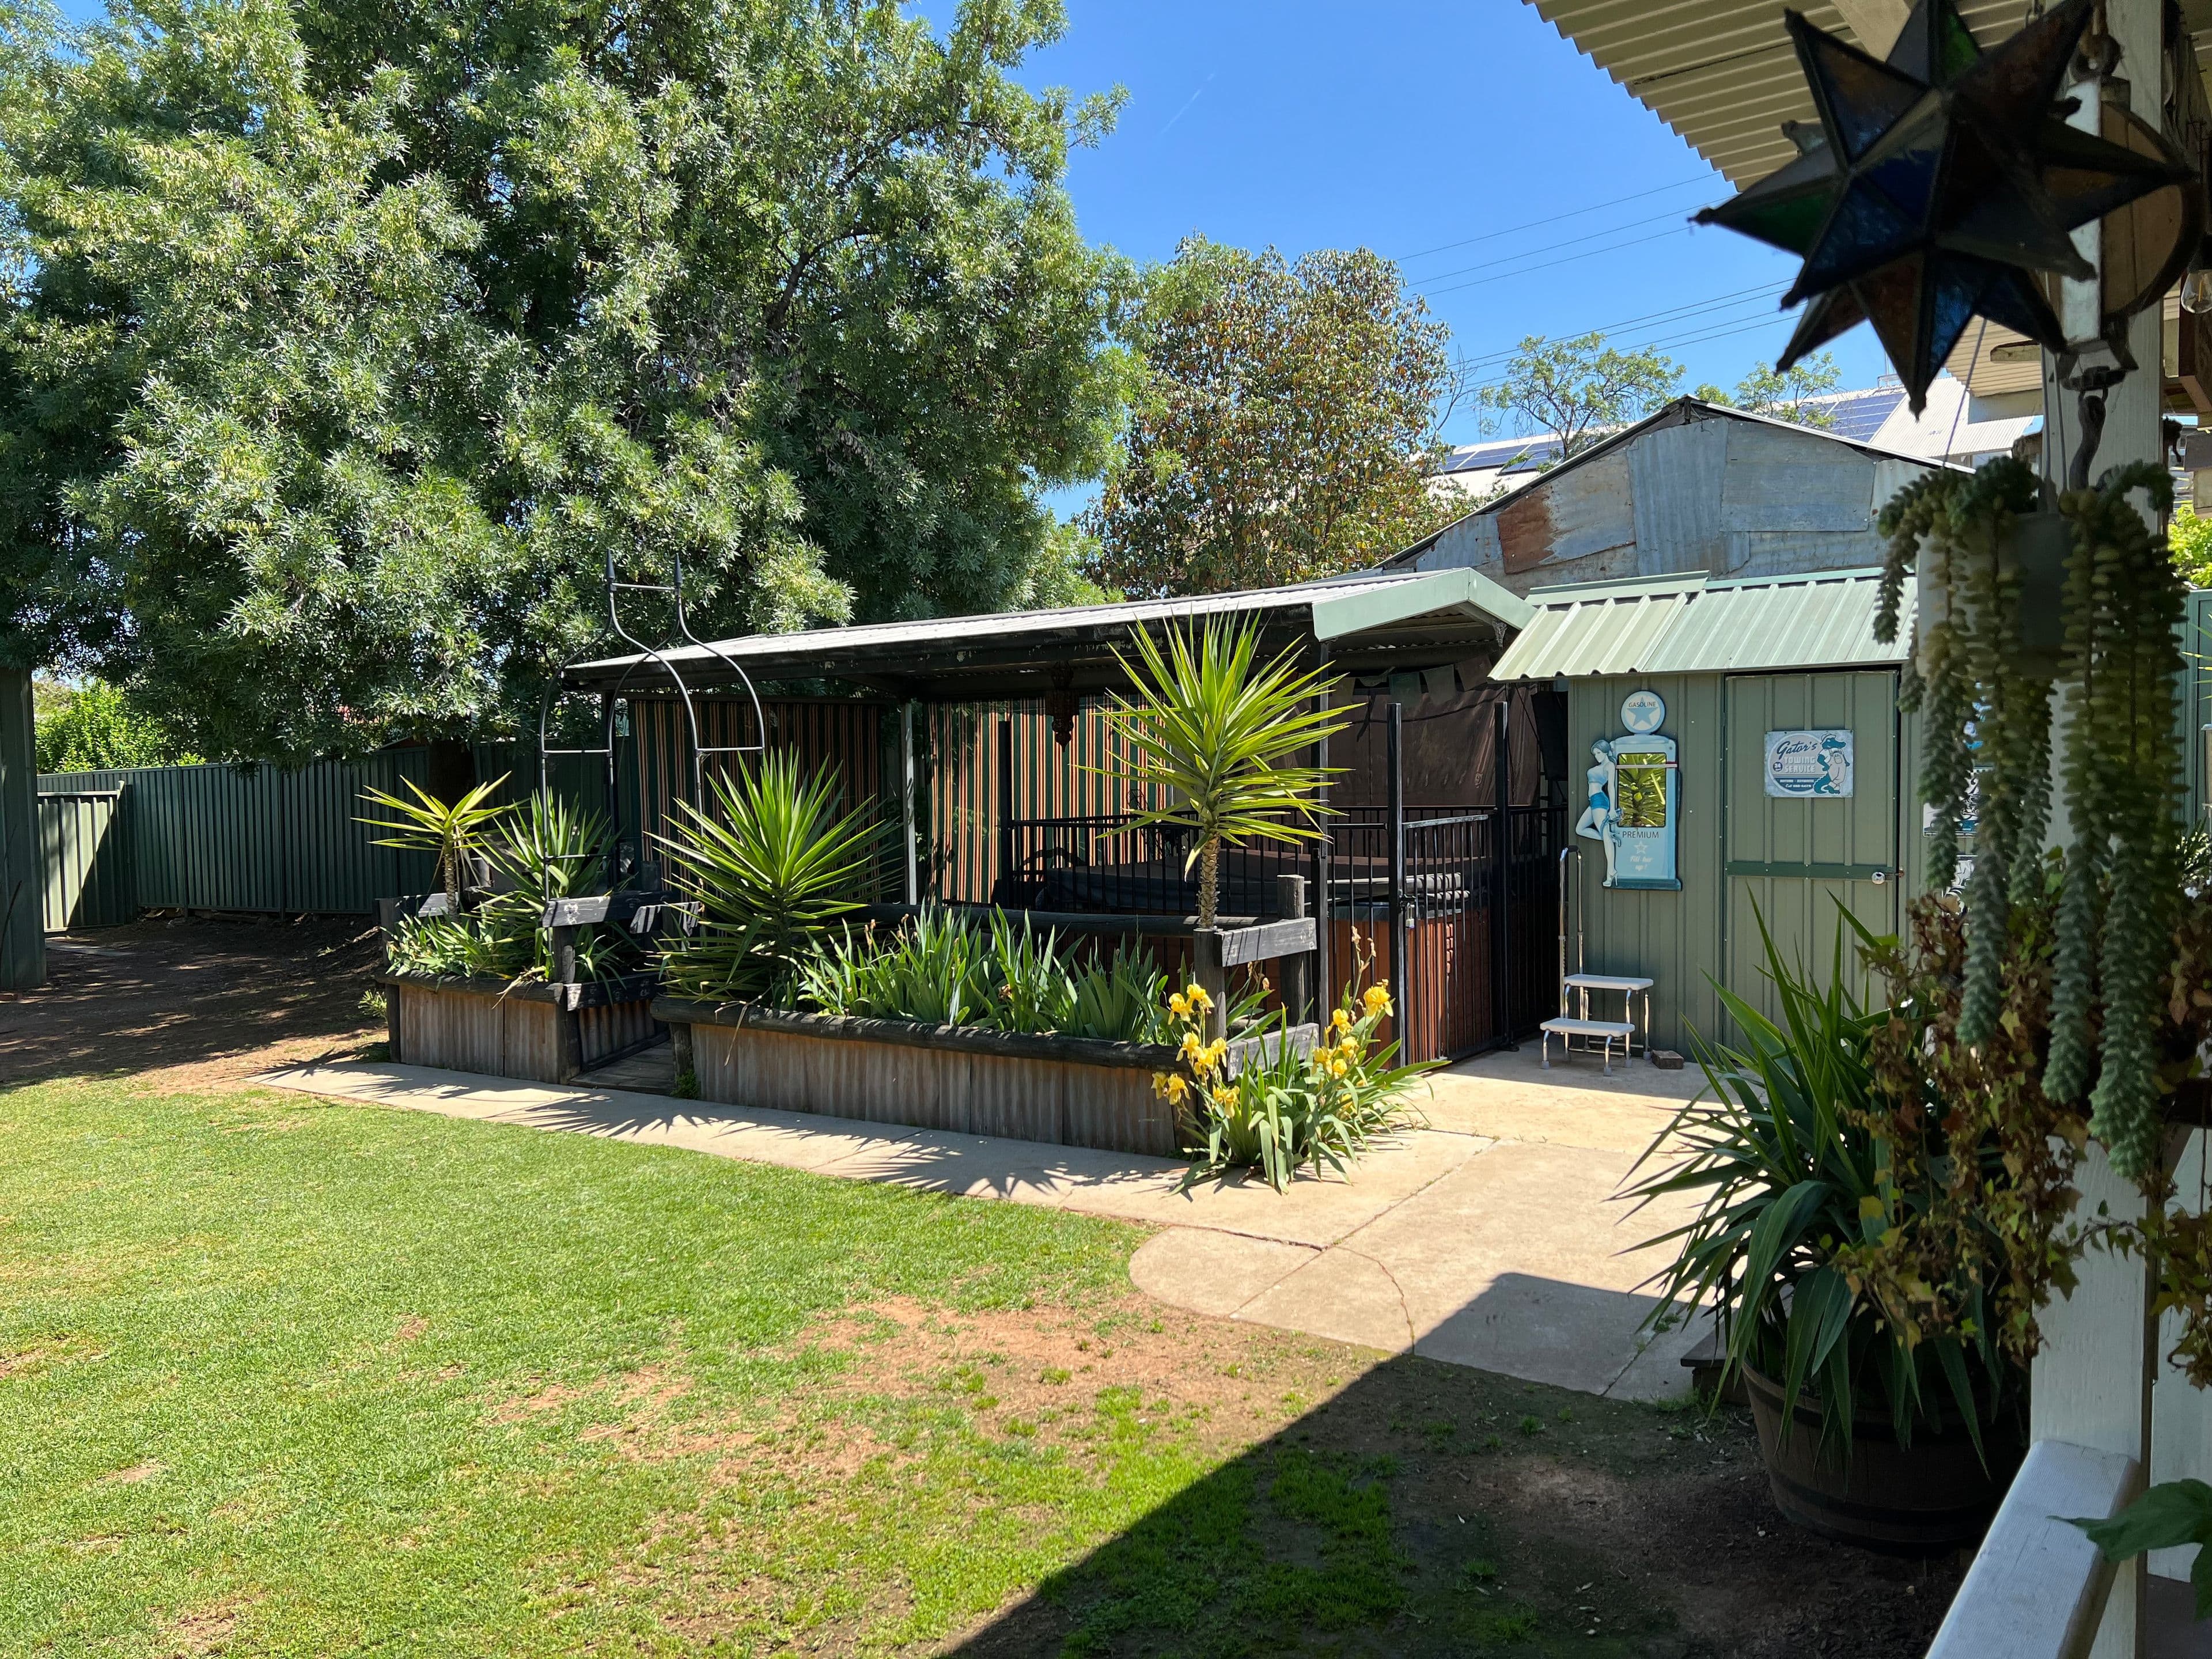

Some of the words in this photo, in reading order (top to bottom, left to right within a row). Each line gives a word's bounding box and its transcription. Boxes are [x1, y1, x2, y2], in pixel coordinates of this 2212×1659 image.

[1777, 740, 1818, 760] Gator's
[1784, 756, 1816, 764] TOWING
[1785, 765, 1816, 773] SERVICE
[1622, 831, 1659, 839] PREMIUM
